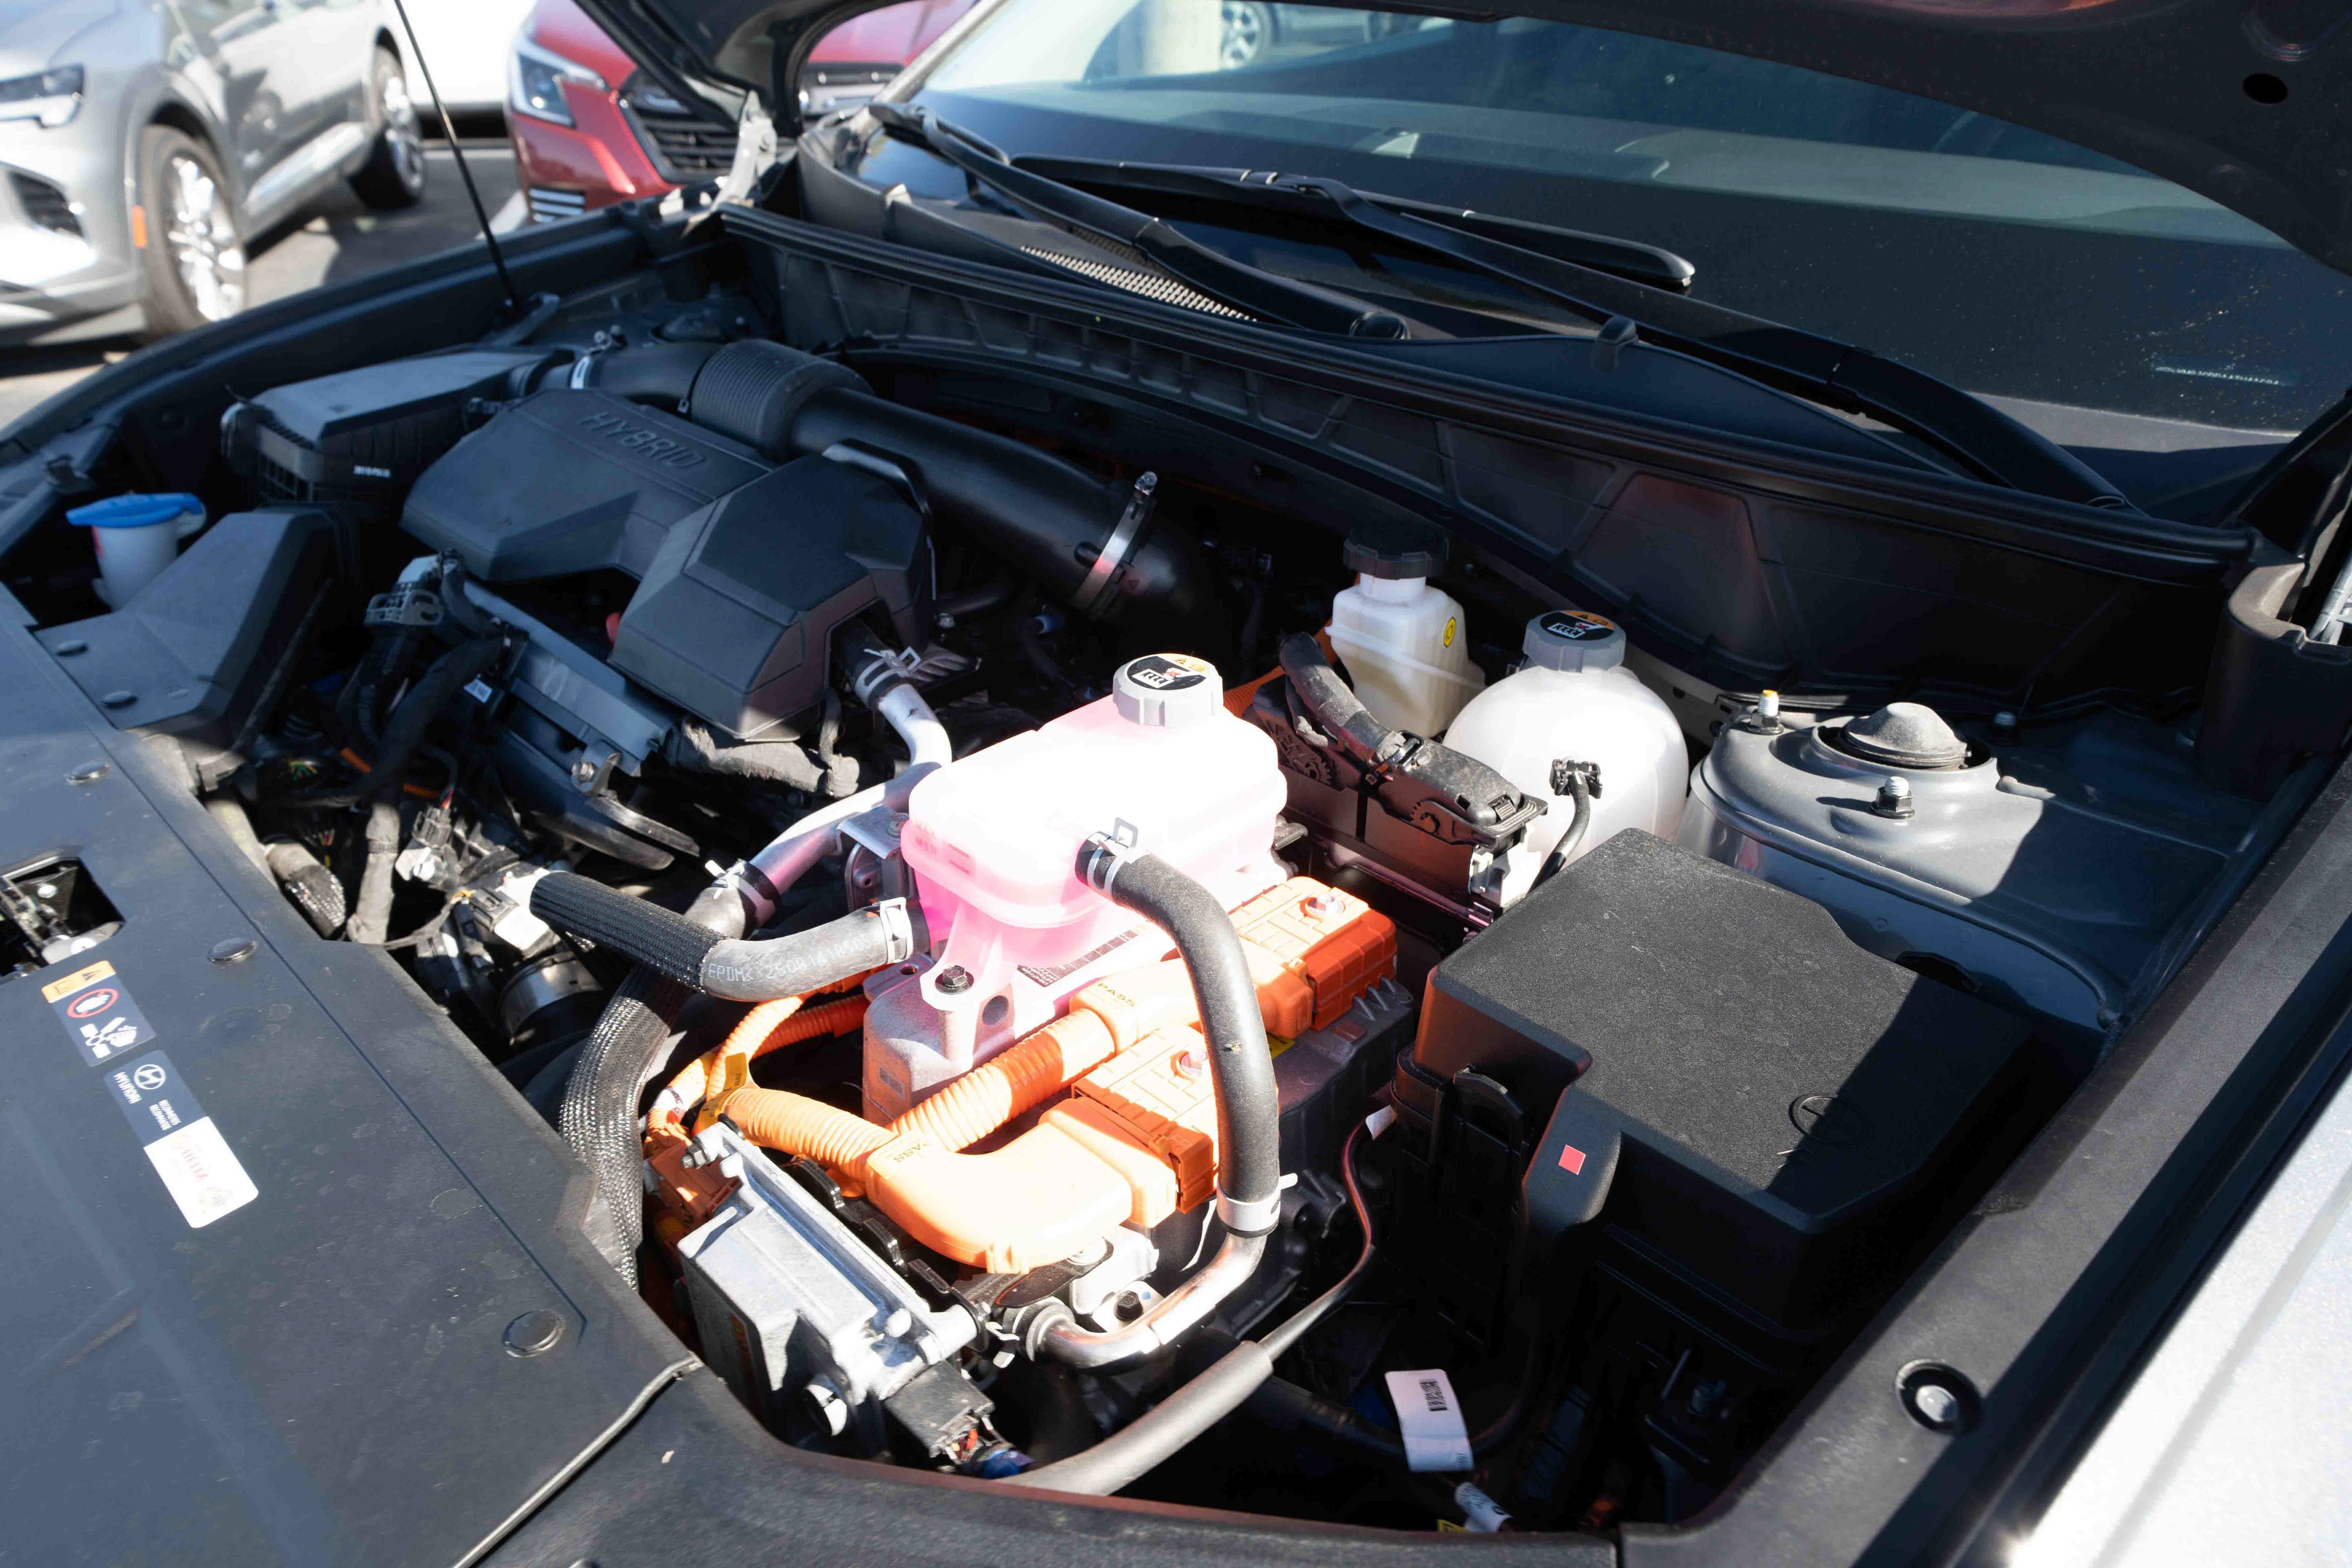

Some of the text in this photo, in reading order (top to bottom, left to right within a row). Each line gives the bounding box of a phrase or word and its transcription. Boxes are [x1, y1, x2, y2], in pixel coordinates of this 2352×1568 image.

[576, 412, 706, 468] HYBRID
[1098, 983, 1136, 1007] PASS
[113, 1071, 142, 1104] HYUNDAI
